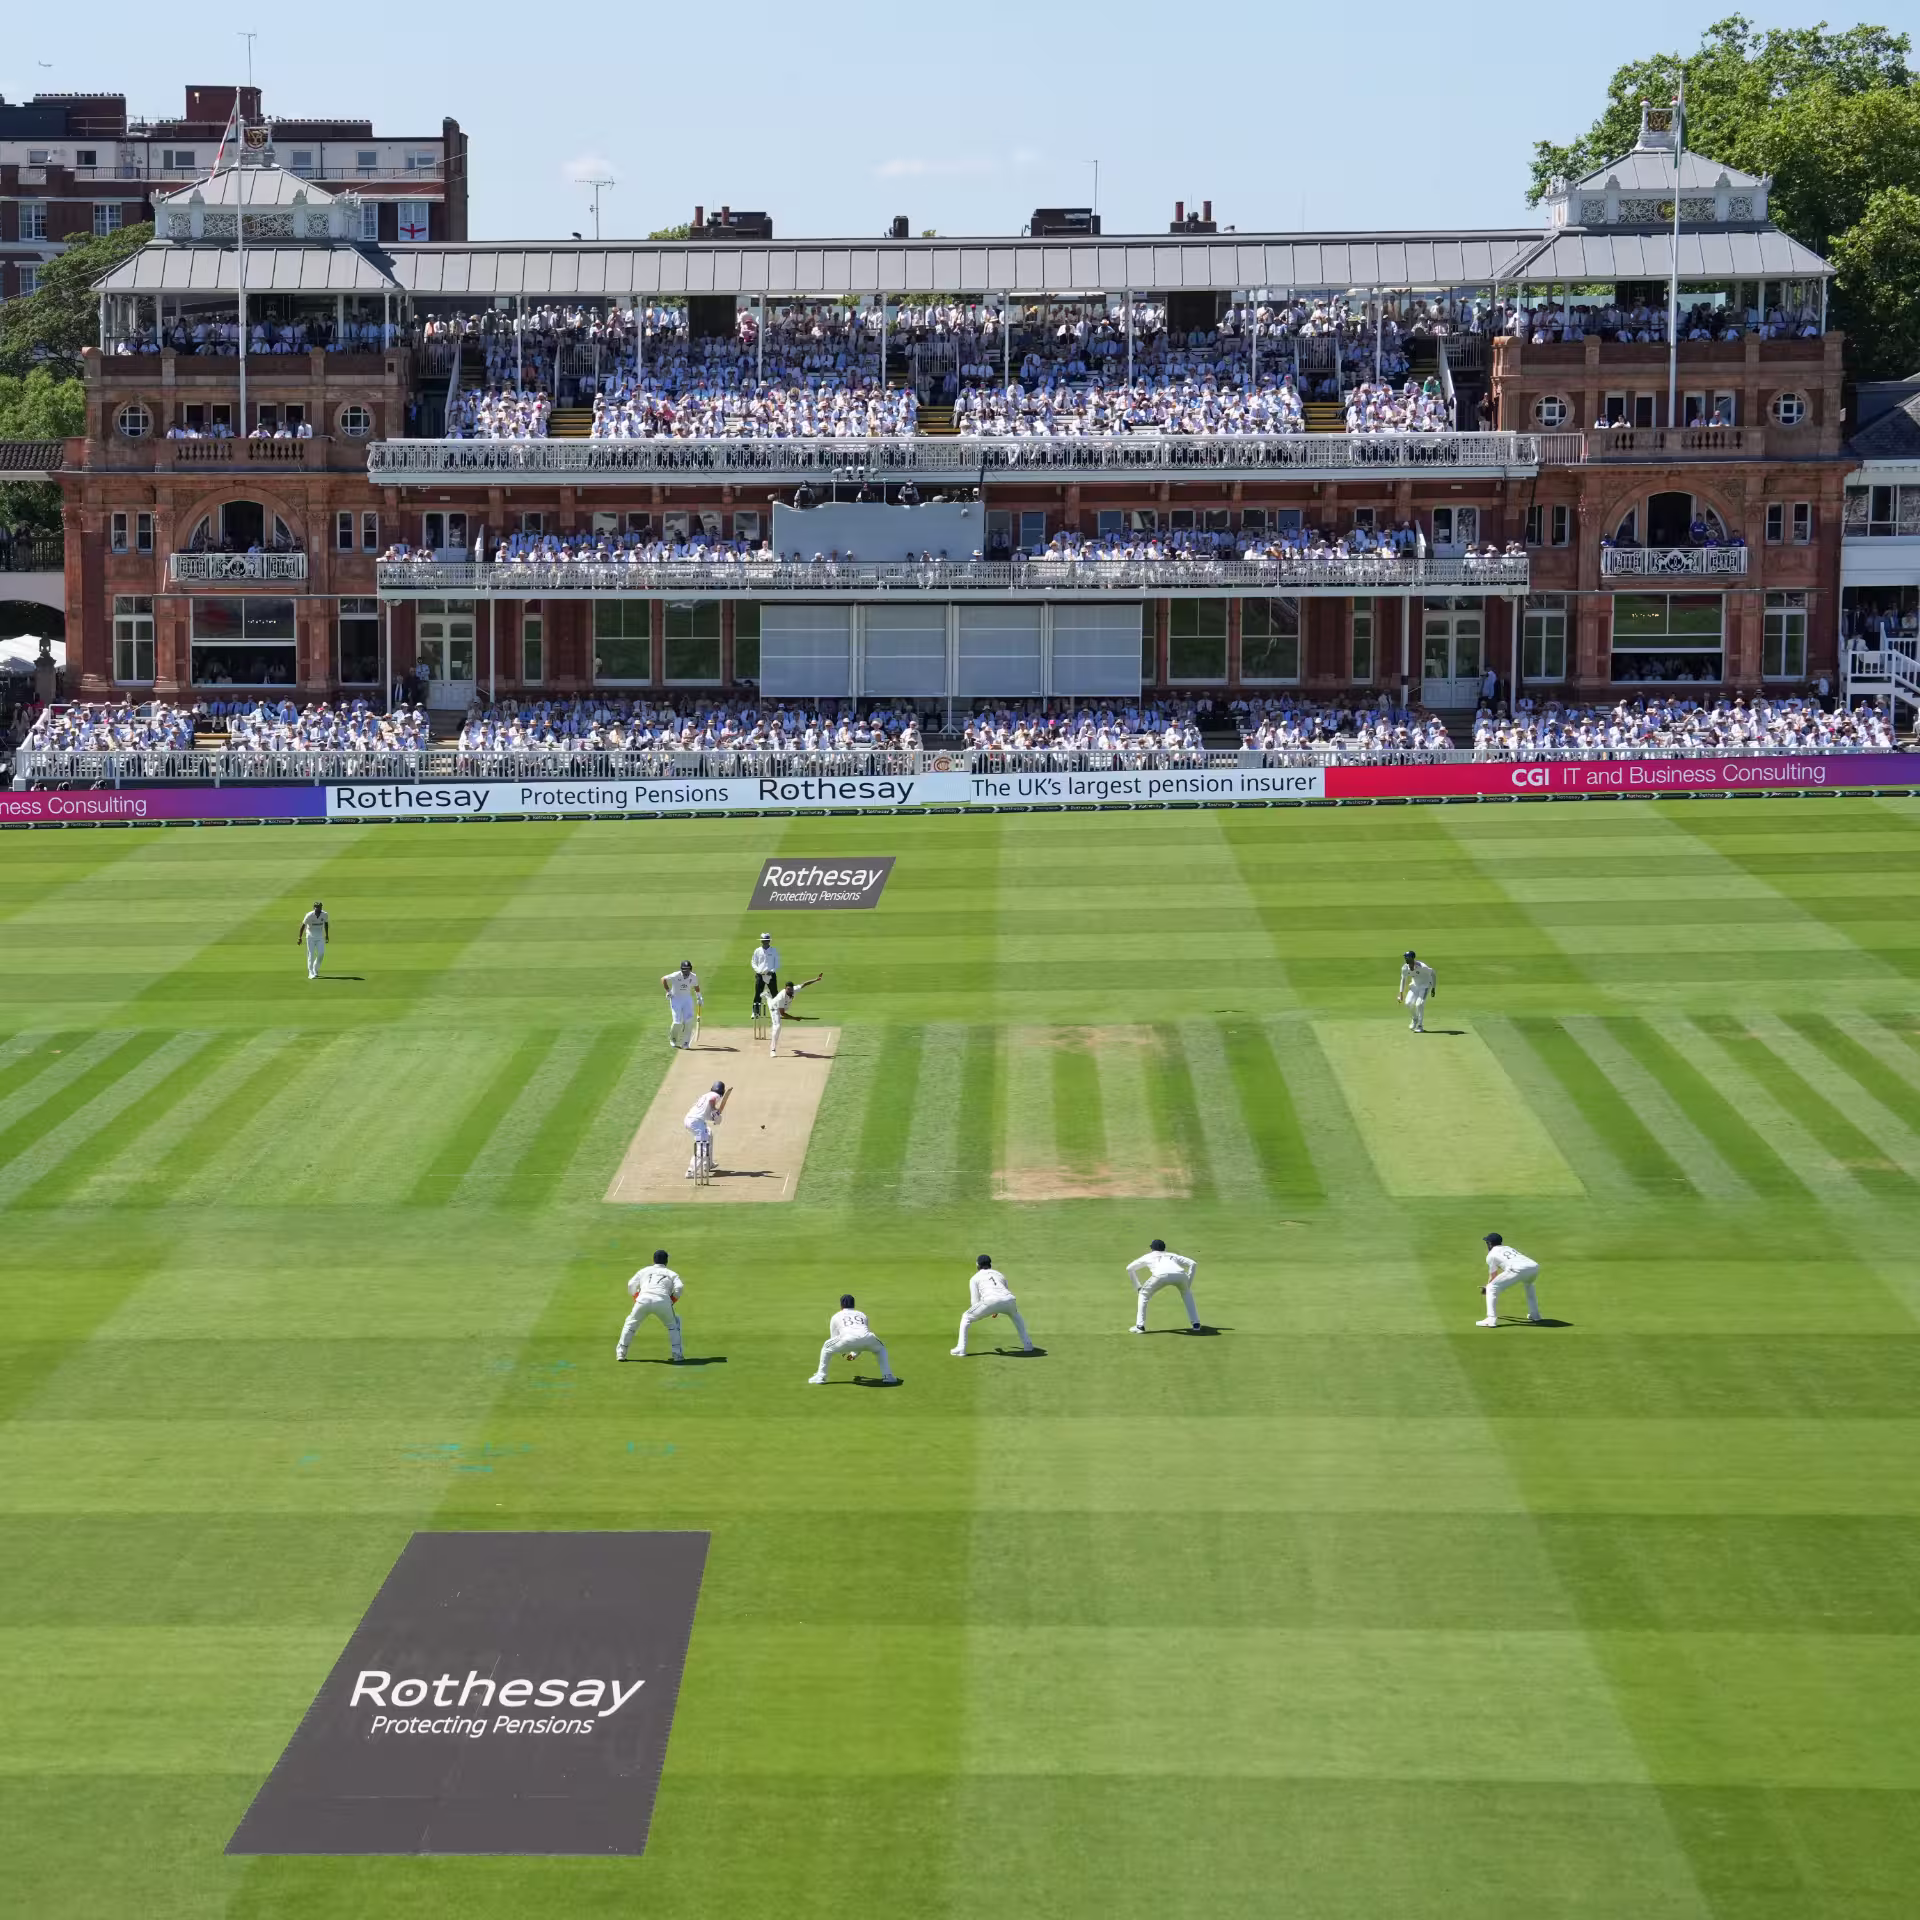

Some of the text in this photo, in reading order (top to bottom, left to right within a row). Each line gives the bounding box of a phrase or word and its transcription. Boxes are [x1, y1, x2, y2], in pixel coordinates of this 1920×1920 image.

[1511, 762, 1826, 786] CGI IT and Business Consulting
[521, 784, 729, 808] Protecting Pensions
[759, 777, 915, 804] Rothesay
[972, 774, 1317, 800] The UK’s largest pension insurer
[0, 796, 147, 817] ness Consulting
[336, 787, 490, 812] Rothesay
[763, 866, 883, 891] Rothesay
[769, 890, 861, 904] Protecting Pensions
[349, 1670, 646, 1717] Rothesay
[370, 1715, 595, 1738] Protecting Pensions
